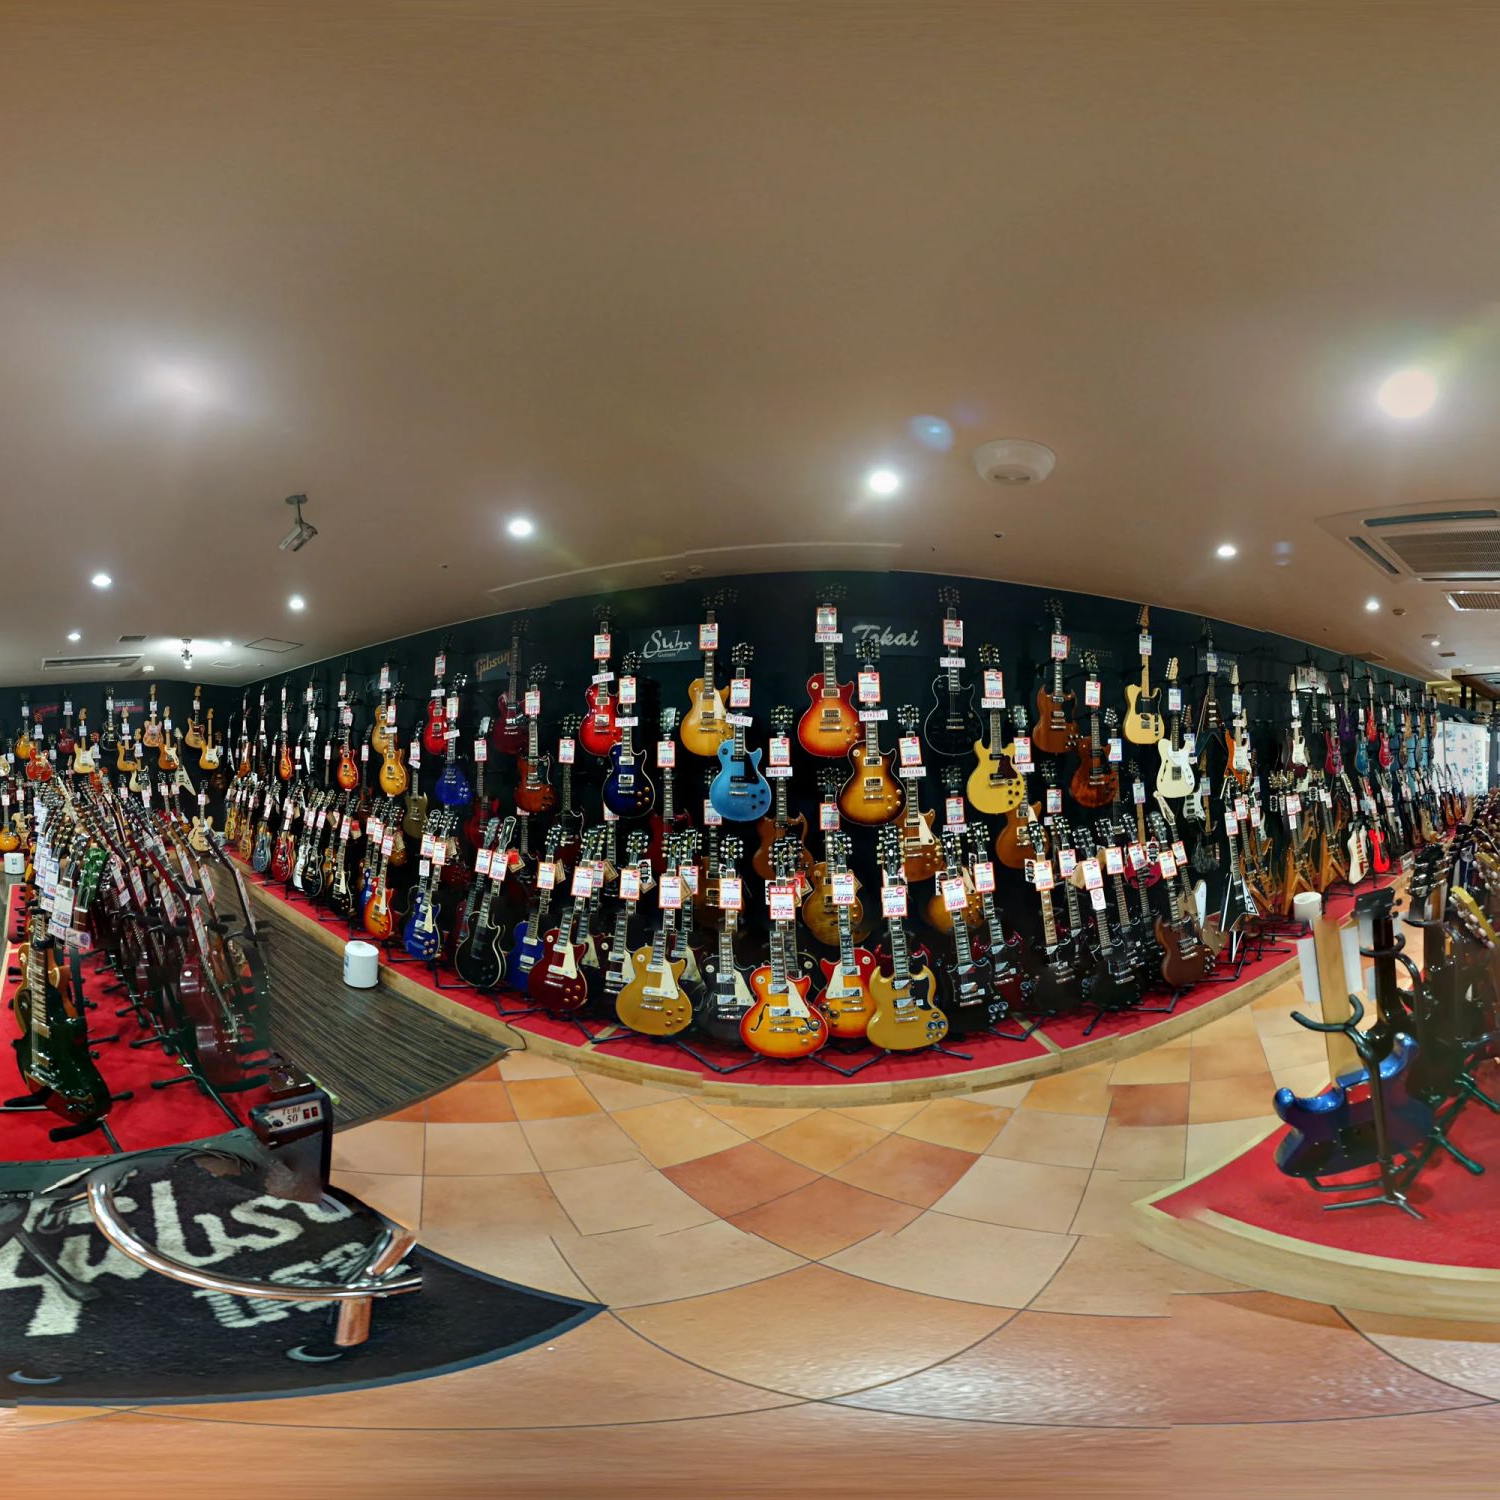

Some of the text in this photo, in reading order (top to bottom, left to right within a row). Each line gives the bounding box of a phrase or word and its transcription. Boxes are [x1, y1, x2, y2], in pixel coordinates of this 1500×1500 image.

[641, 629, 692, 658] Suhr
[852, 624, 919, 646] Tokai
[476, 648, 511, 681] Gibson
[282, 1106, 301, 1116] TUBE
[286, 1113, 299, 1124] 50
